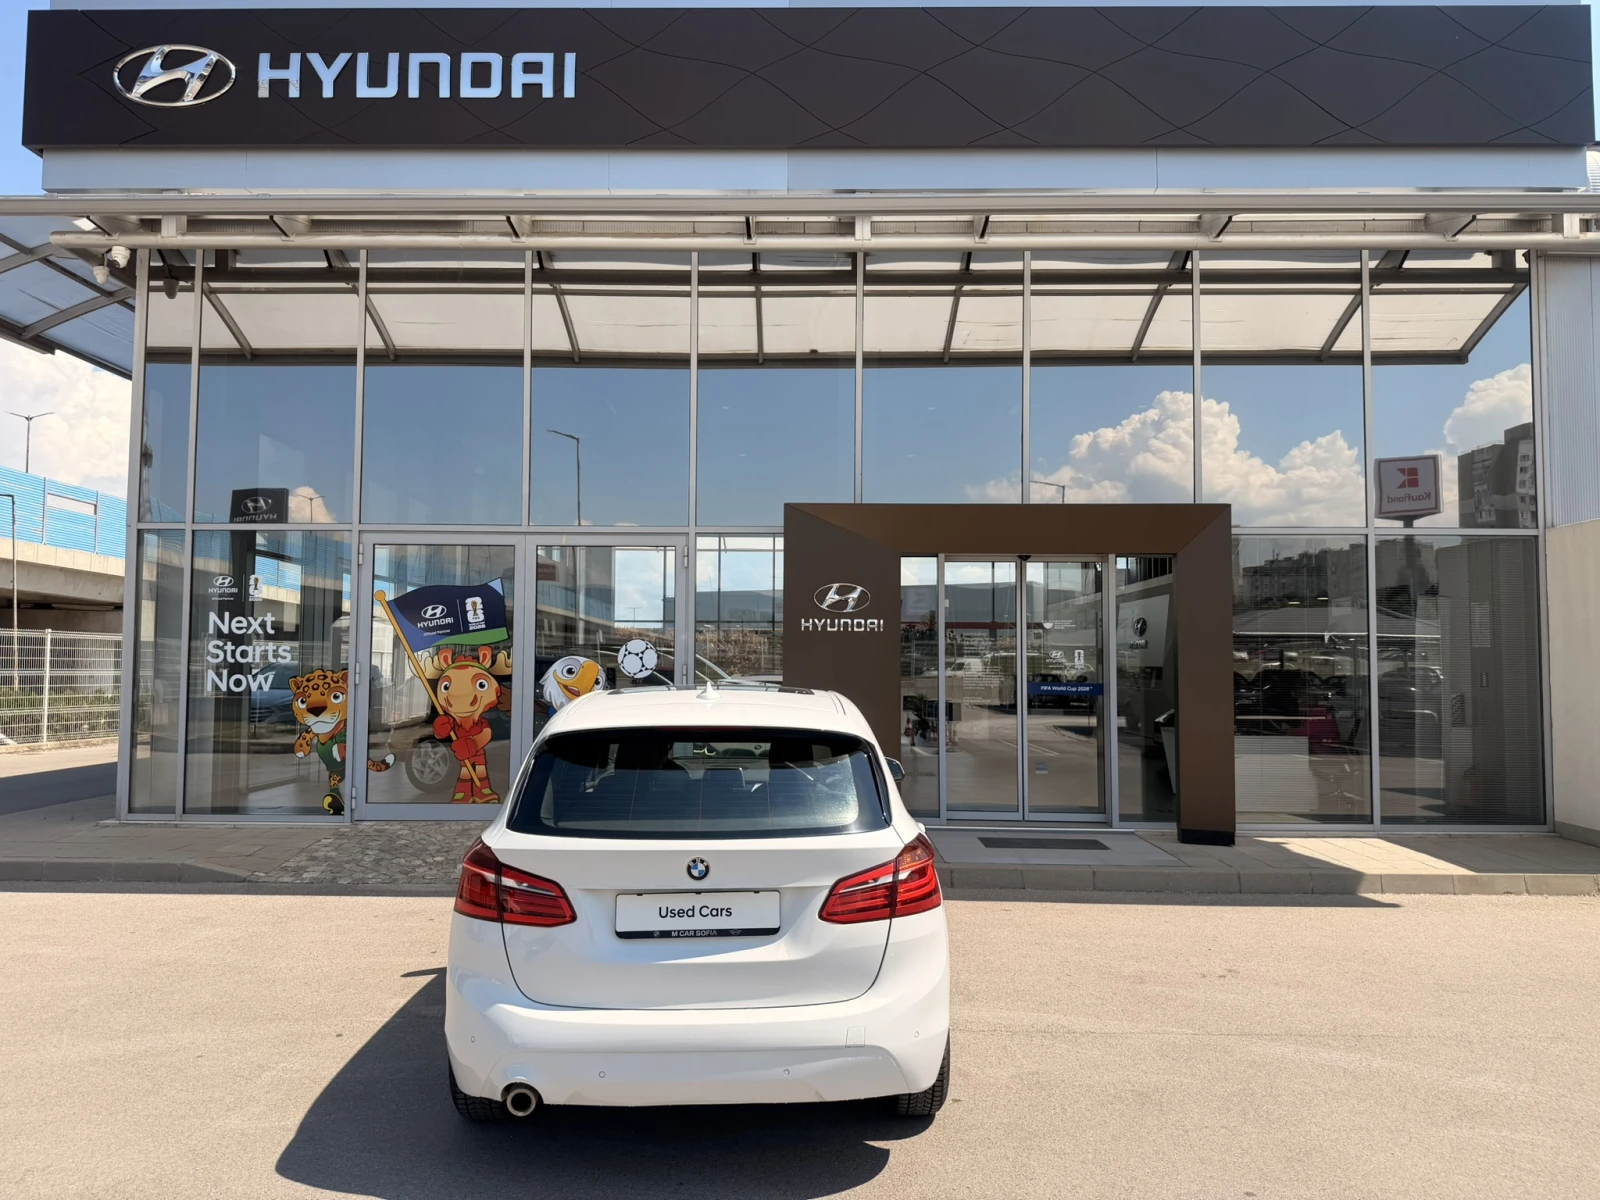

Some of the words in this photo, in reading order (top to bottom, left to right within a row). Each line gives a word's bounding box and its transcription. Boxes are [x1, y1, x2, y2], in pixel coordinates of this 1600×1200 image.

[257, 52, 577, 99] HYUNDAI
[208, 611, 276, 635] Next
[417, 617, 454, 628] HYUNDAI
[801, 618, 884, 632] HYUNDAI
[206, 640, 292, 664] Starts
[206, 669, 275, 692] Now
[658, 905, 695, 919] Used
[699, 905, 733, 918] Cars
[695, 929, 718, 937] SOFIA
